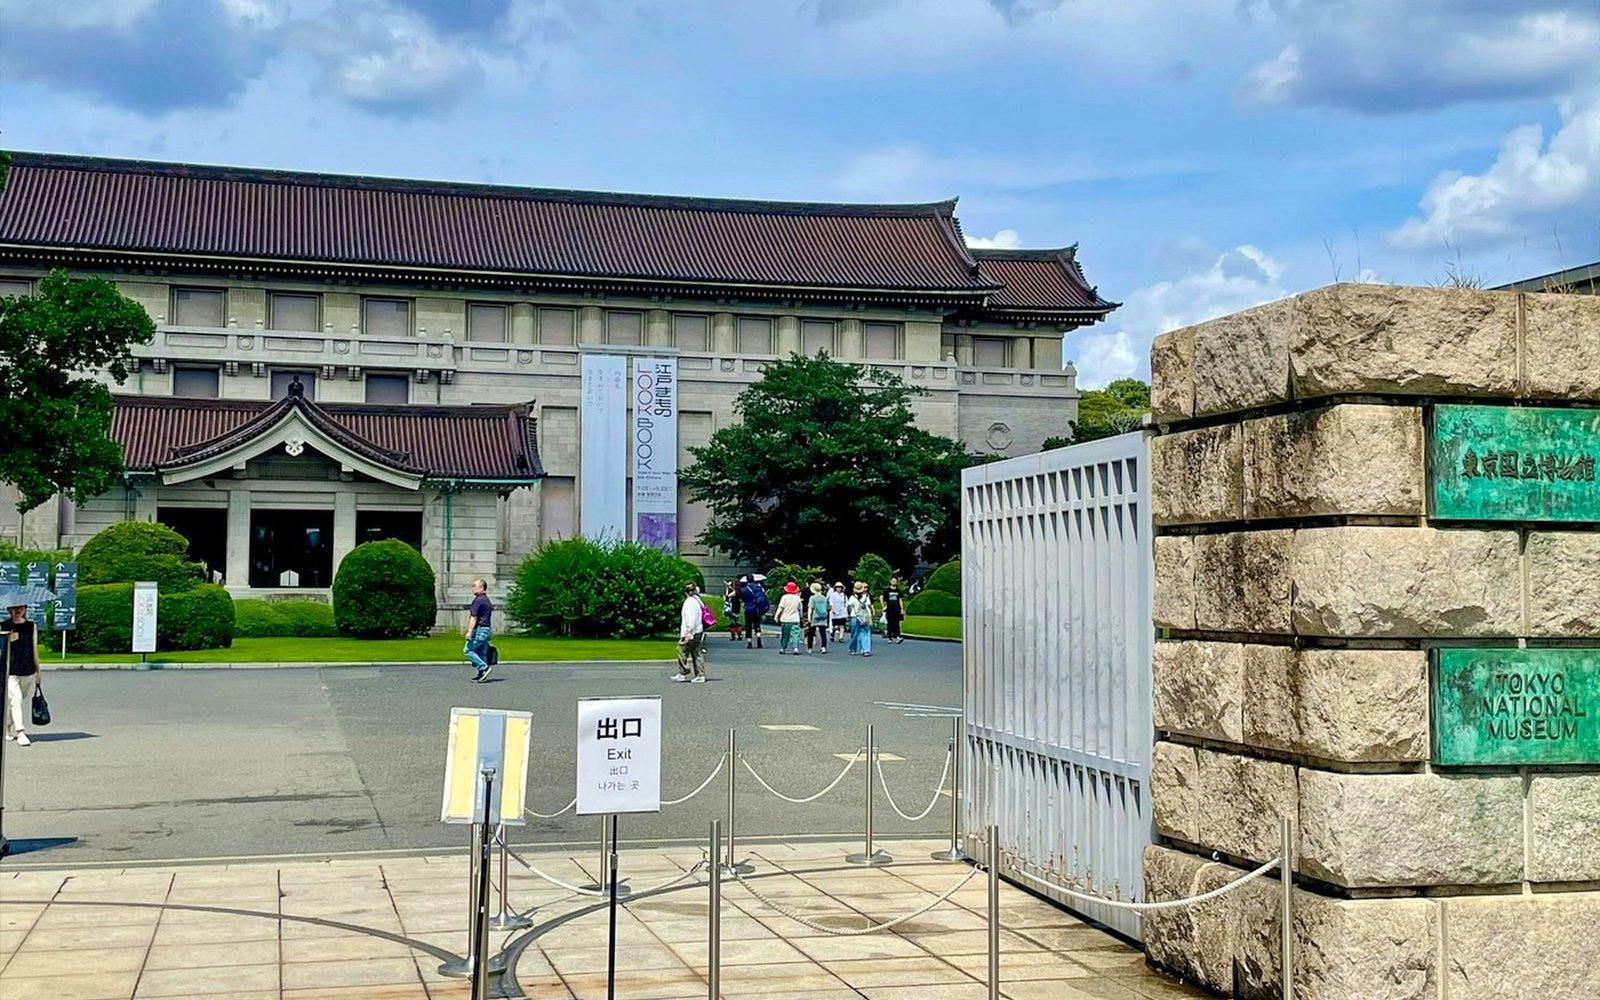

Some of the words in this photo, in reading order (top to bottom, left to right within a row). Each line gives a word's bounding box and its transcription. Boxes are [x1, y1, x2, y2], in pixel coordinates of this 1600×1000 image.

[637, 363, 653, 416] LOOK
[637, 417, 653, 470] BOOK
[1461, 449, 1596, 482] 東京国立博物館
[1496, 672, 1565, 695] TOKYO
[1481, 695, 1587, 717] NATIONAL
[596, 717, 642, 740] 出口
[1487, 718, 1578, 740] MUSEUM
[607, 748, 632, 760] Exit
[609, 765, 629, 776] 出口
[598, 780, 626, 791] 나가는
[630, 780, 640, 791] 곳
